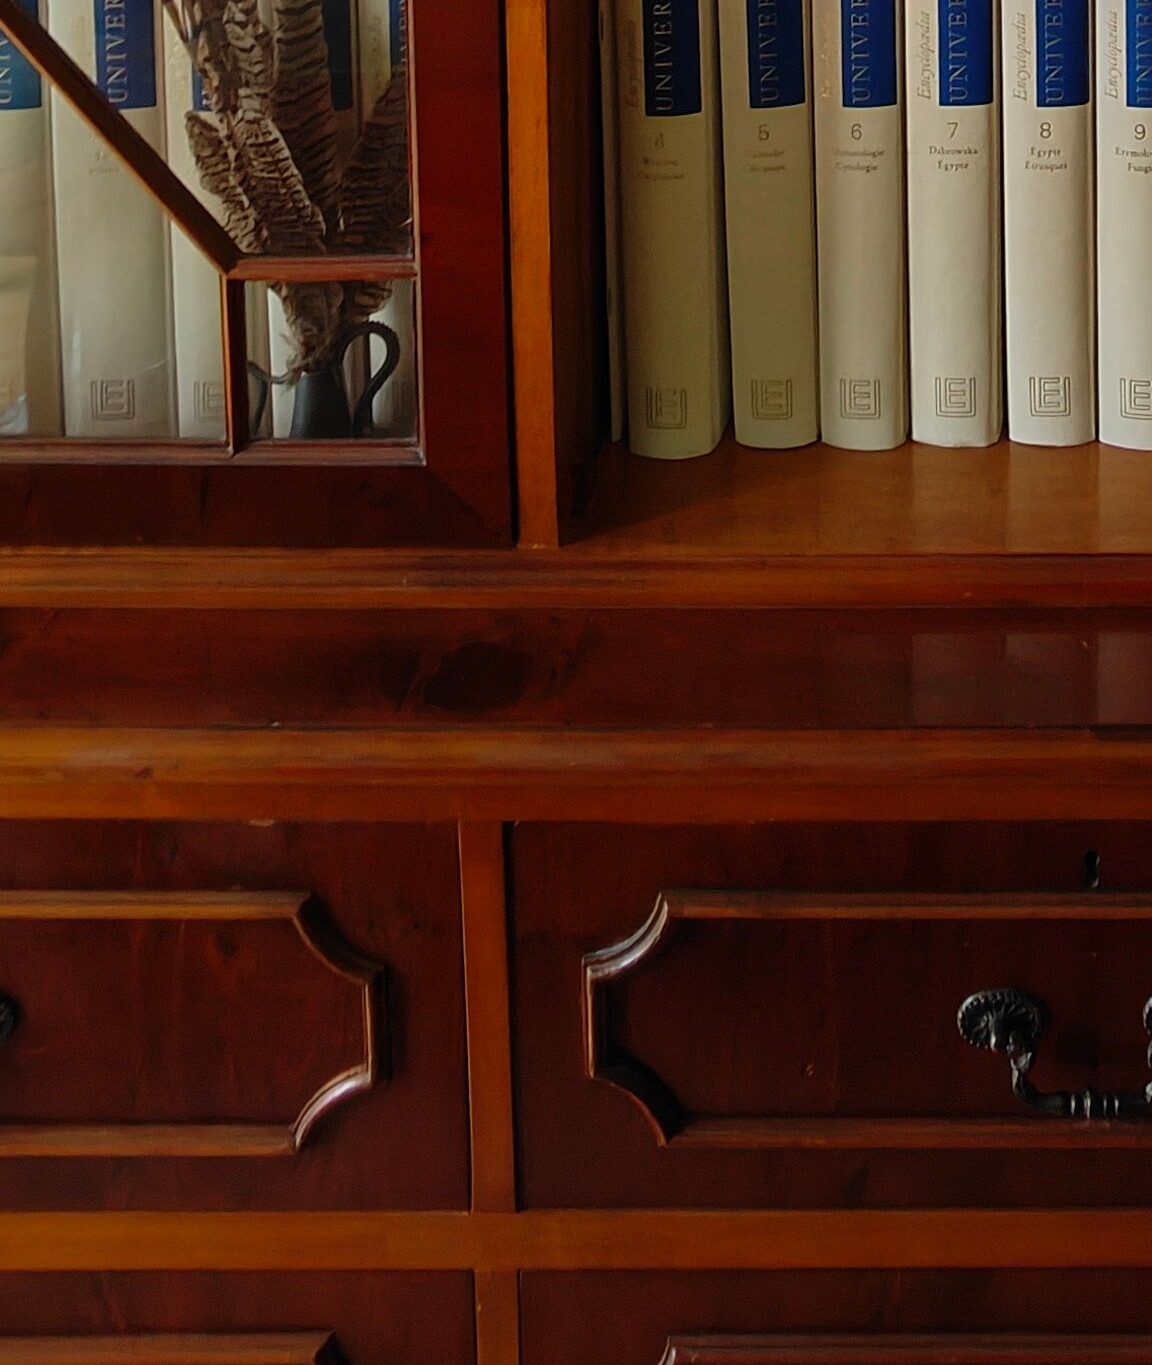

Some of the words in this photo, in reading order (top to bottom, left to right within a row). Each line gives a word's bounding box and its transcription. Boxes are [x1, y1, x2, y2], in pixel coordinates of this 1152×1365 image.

[758, 125, 770, 142] 5
[850, 123, 863, 141] 6
[946, 122, 959, 139] 7
[1039, 122, 1053, 139] 8
[1133, 123, 1147, 141] 9
